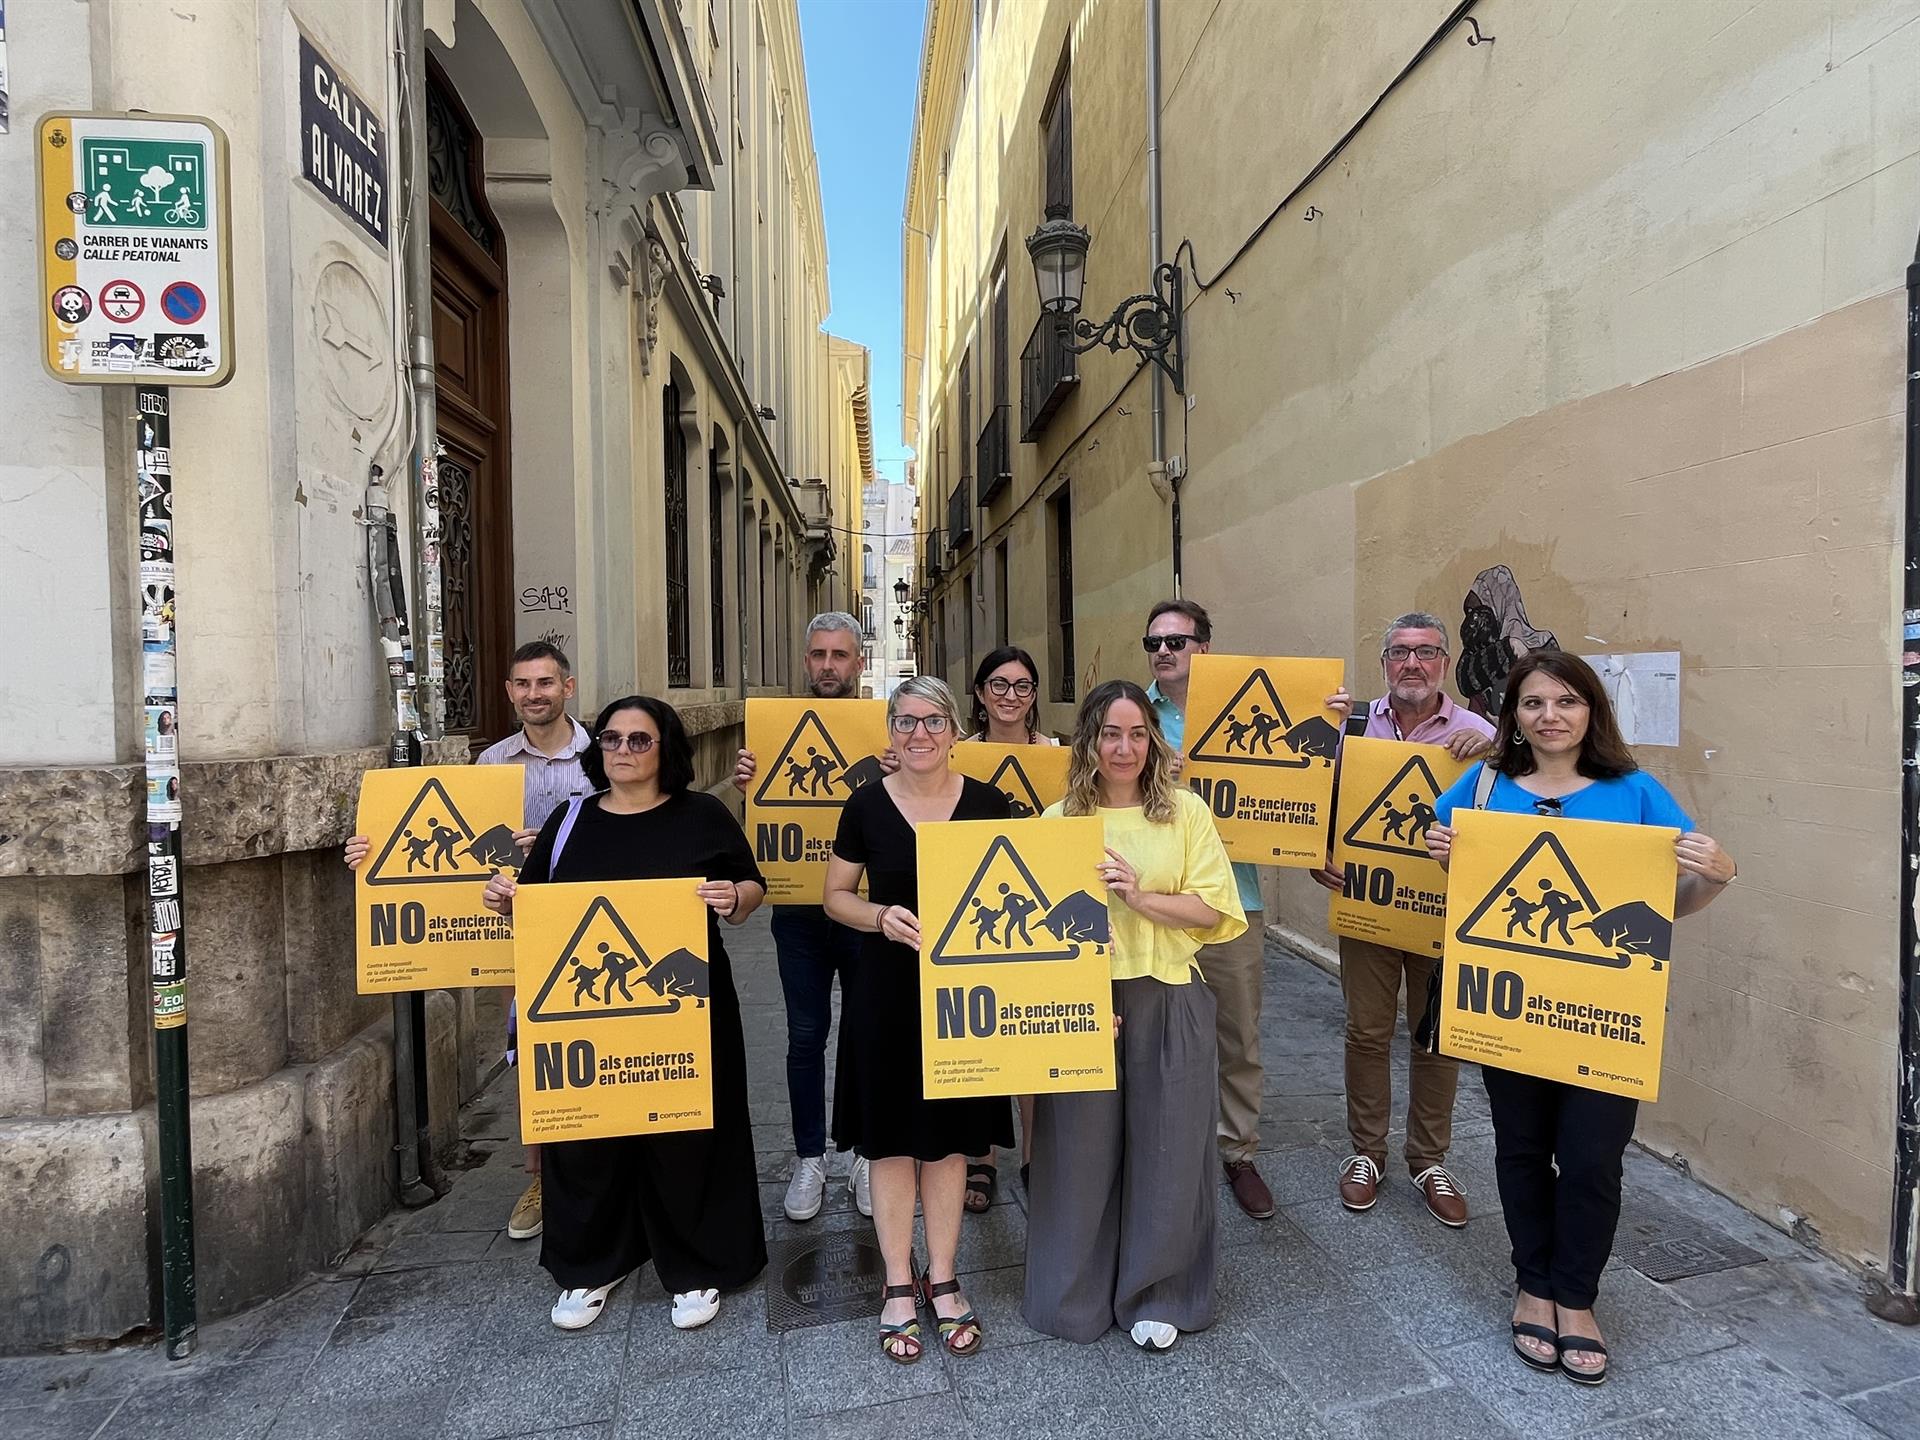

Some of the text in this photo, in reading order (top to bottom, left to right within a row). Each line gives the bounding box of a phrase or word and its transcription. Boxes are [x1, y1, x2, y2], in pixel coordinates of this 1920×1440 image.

[314, 63, 378, 157] CALLE
[312, 123, 382, 233] ALVAREZ
[83, 236, 208, 250] CARRER DE VIANANTS
[83, 248, 120, 260] CALLE
[122, 250, 181, 262] PEATONAL
[1189, 777, 1237, 818] NO
[1238, 795, 1317, 812] als encierros
[1237, 809, 1319, 826] en Ciutat Vella.
[756, 823, 803, 862] NO
[806, 837, 822, 850] als
[805, 852, 818, 862] en
[1342, 861, 1395, 906] NO
[1396, 886, 1416, 899] als
[1394, 900, 1408, 910] en
[370, 901, 425, 946] NO
[429, 915, 448, 929] als
[428, 928, 514, 942] en Ciutat Vella.
[164, 993, 184, 1007] EOI
[1456, 963, 1524, 1020] NO
[936, 985, 997, 1039] NO
[1000, 1001, 1094, 1019] als encierros
[1527, 994, 1642, 1028] als encierros
[1000, 1018, 1100, 1036] en Ciutat Vella.
[1525, 1012, 1646, 1045] en Ciutat Vella.
[533, 1039, 596, 1091] NO
[599, 1052, 694, 1071] als encierros
[599, 1066, 699, 1085] en Ciutat Vella.
[1060, 1066, 1103, 1076] compromís
[659, 1108, 702, 1119] compromís
